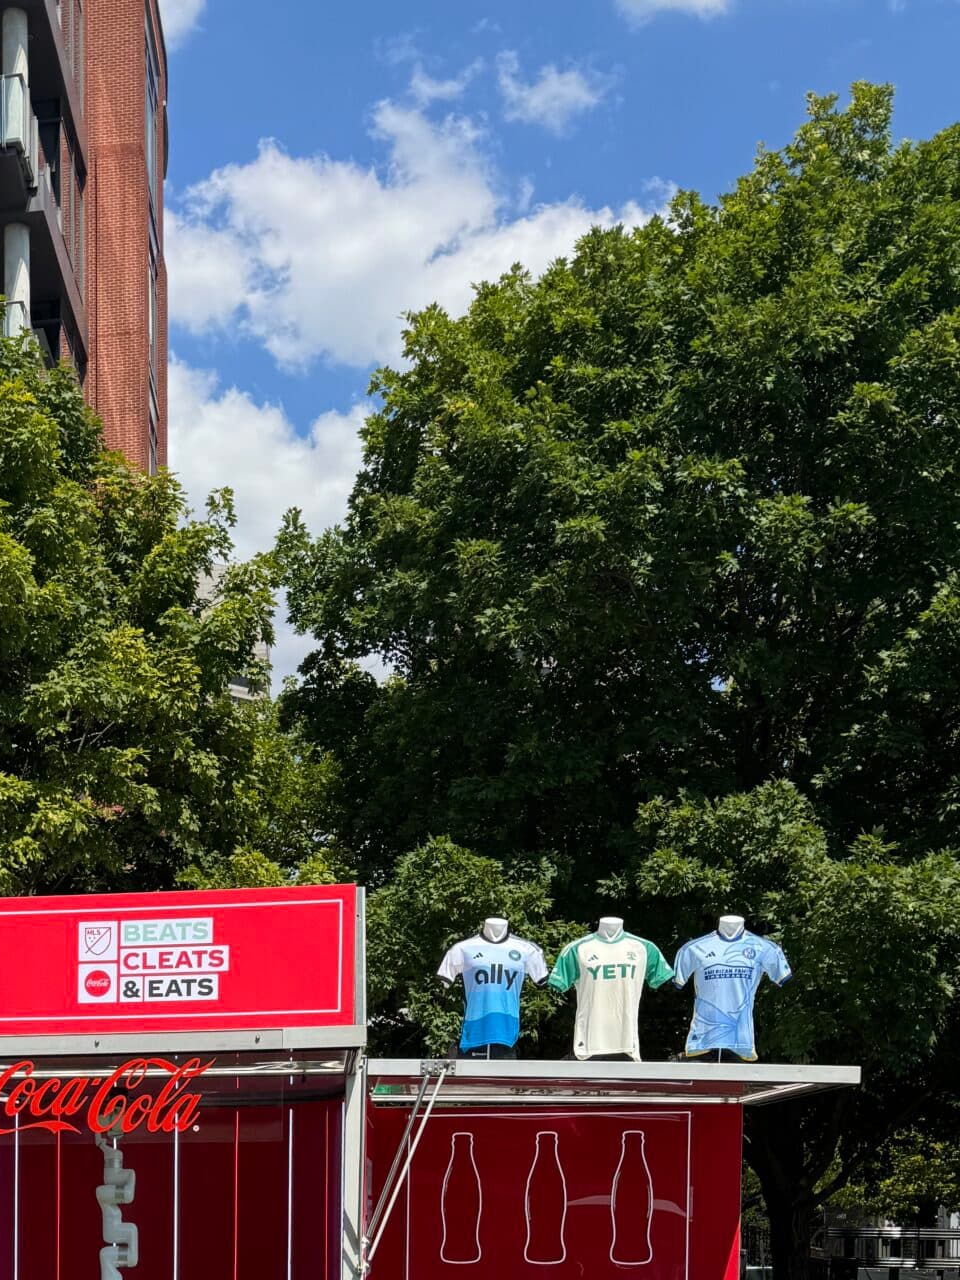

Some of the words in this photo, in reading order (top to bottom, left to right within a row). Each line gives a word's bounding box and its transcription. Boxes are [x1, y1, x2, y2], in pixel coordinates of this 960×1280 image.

[124, 922, 208, 942] BEATS
[123, 950, 225, 970] CLEATS
[475, 964, 519, 990] ally
[587, 964, 636, 980] YETI
[123, 980, 140, 998] &
[148, 978, 213, 997] EATS
